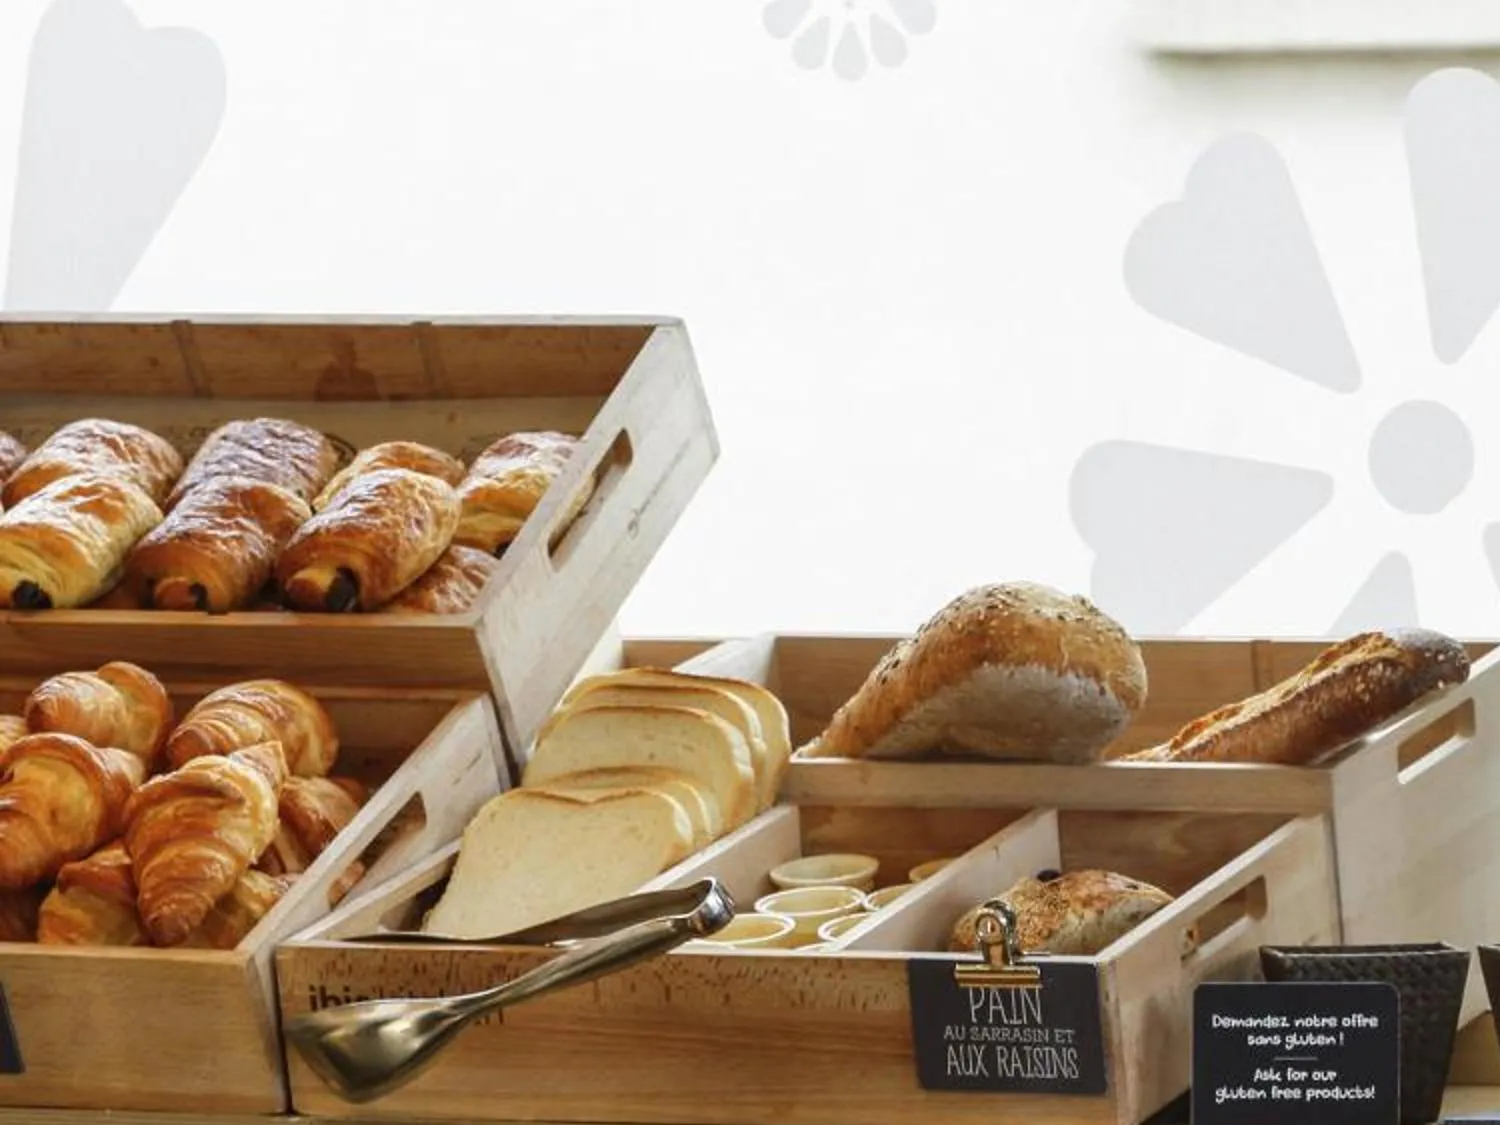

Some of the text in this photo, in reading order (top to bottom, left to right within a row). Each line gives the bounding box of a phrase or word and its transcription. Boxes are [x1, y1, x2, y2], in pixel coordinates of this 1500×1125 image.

[969, 986, 1043, 1025] PAIN
[1211, 1013, 1379, 1029] Demandez notre offre
[943, 1025, 1075, 1044] AU SARRASIN ET
[1247, 1034, 1282, 1046] sans
[1285, 1031, 1337, 1051] gluten
[947, 1044, 1080, 1080] AUX RAISINS
[1253, 1067, 1338, 1083] Ask for our
[1215, 1084, 1376, 1105] gluten free products!
